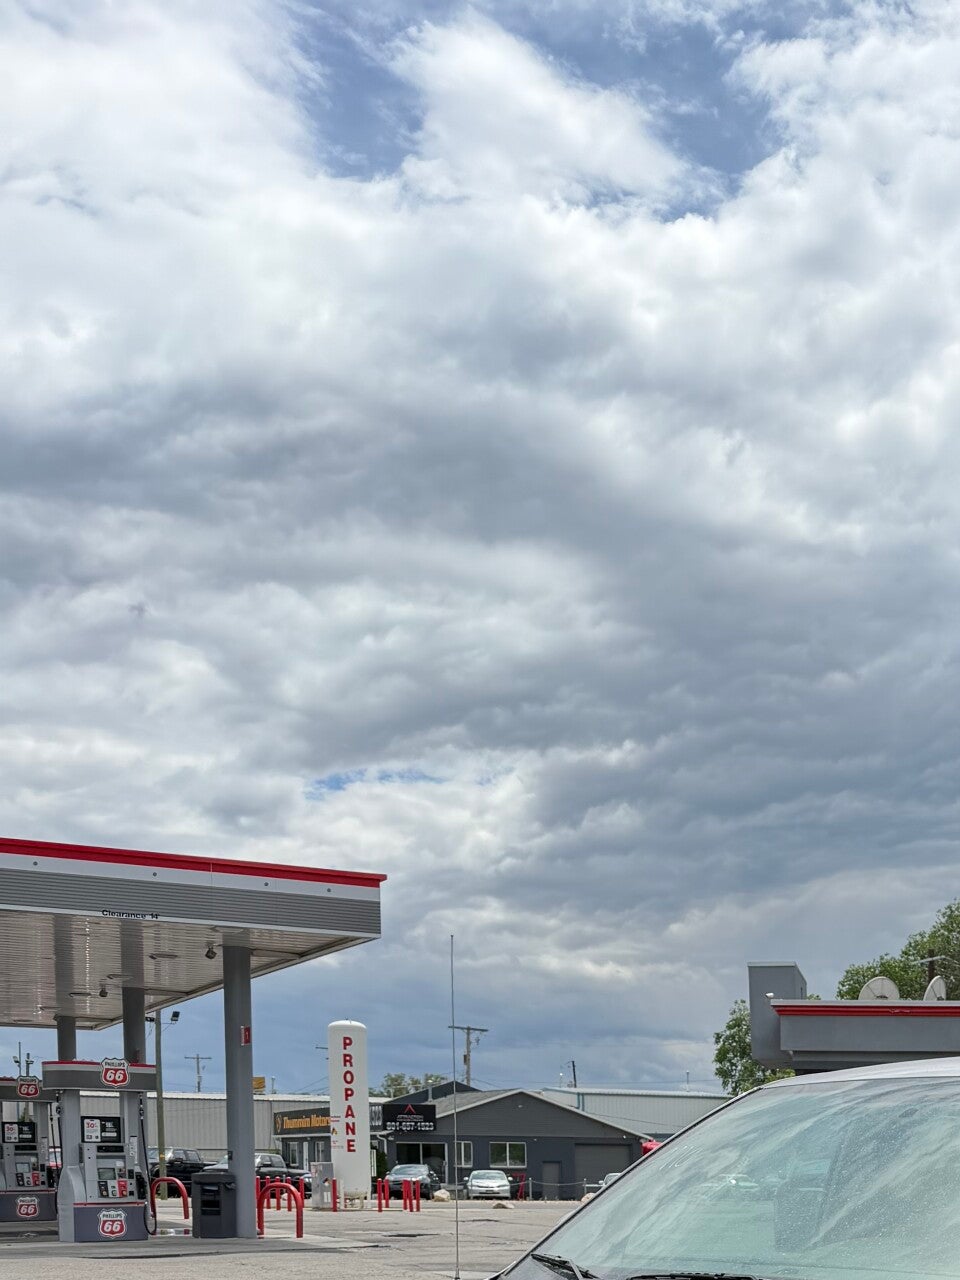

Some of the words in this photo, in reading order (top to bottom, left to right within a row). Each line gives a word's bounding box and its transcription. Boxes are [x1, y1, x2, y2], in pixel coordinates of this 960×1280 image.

[101, 909, 147, 919] Clearance
[106, 1069, 125, 1081] 66
[20, 1085, 37, 1094] 66
[343, 1036, 356, 1153] PROPANE
[20, 1205, 35, 1214] 66
[103, 1221, 122, 1232] 66
